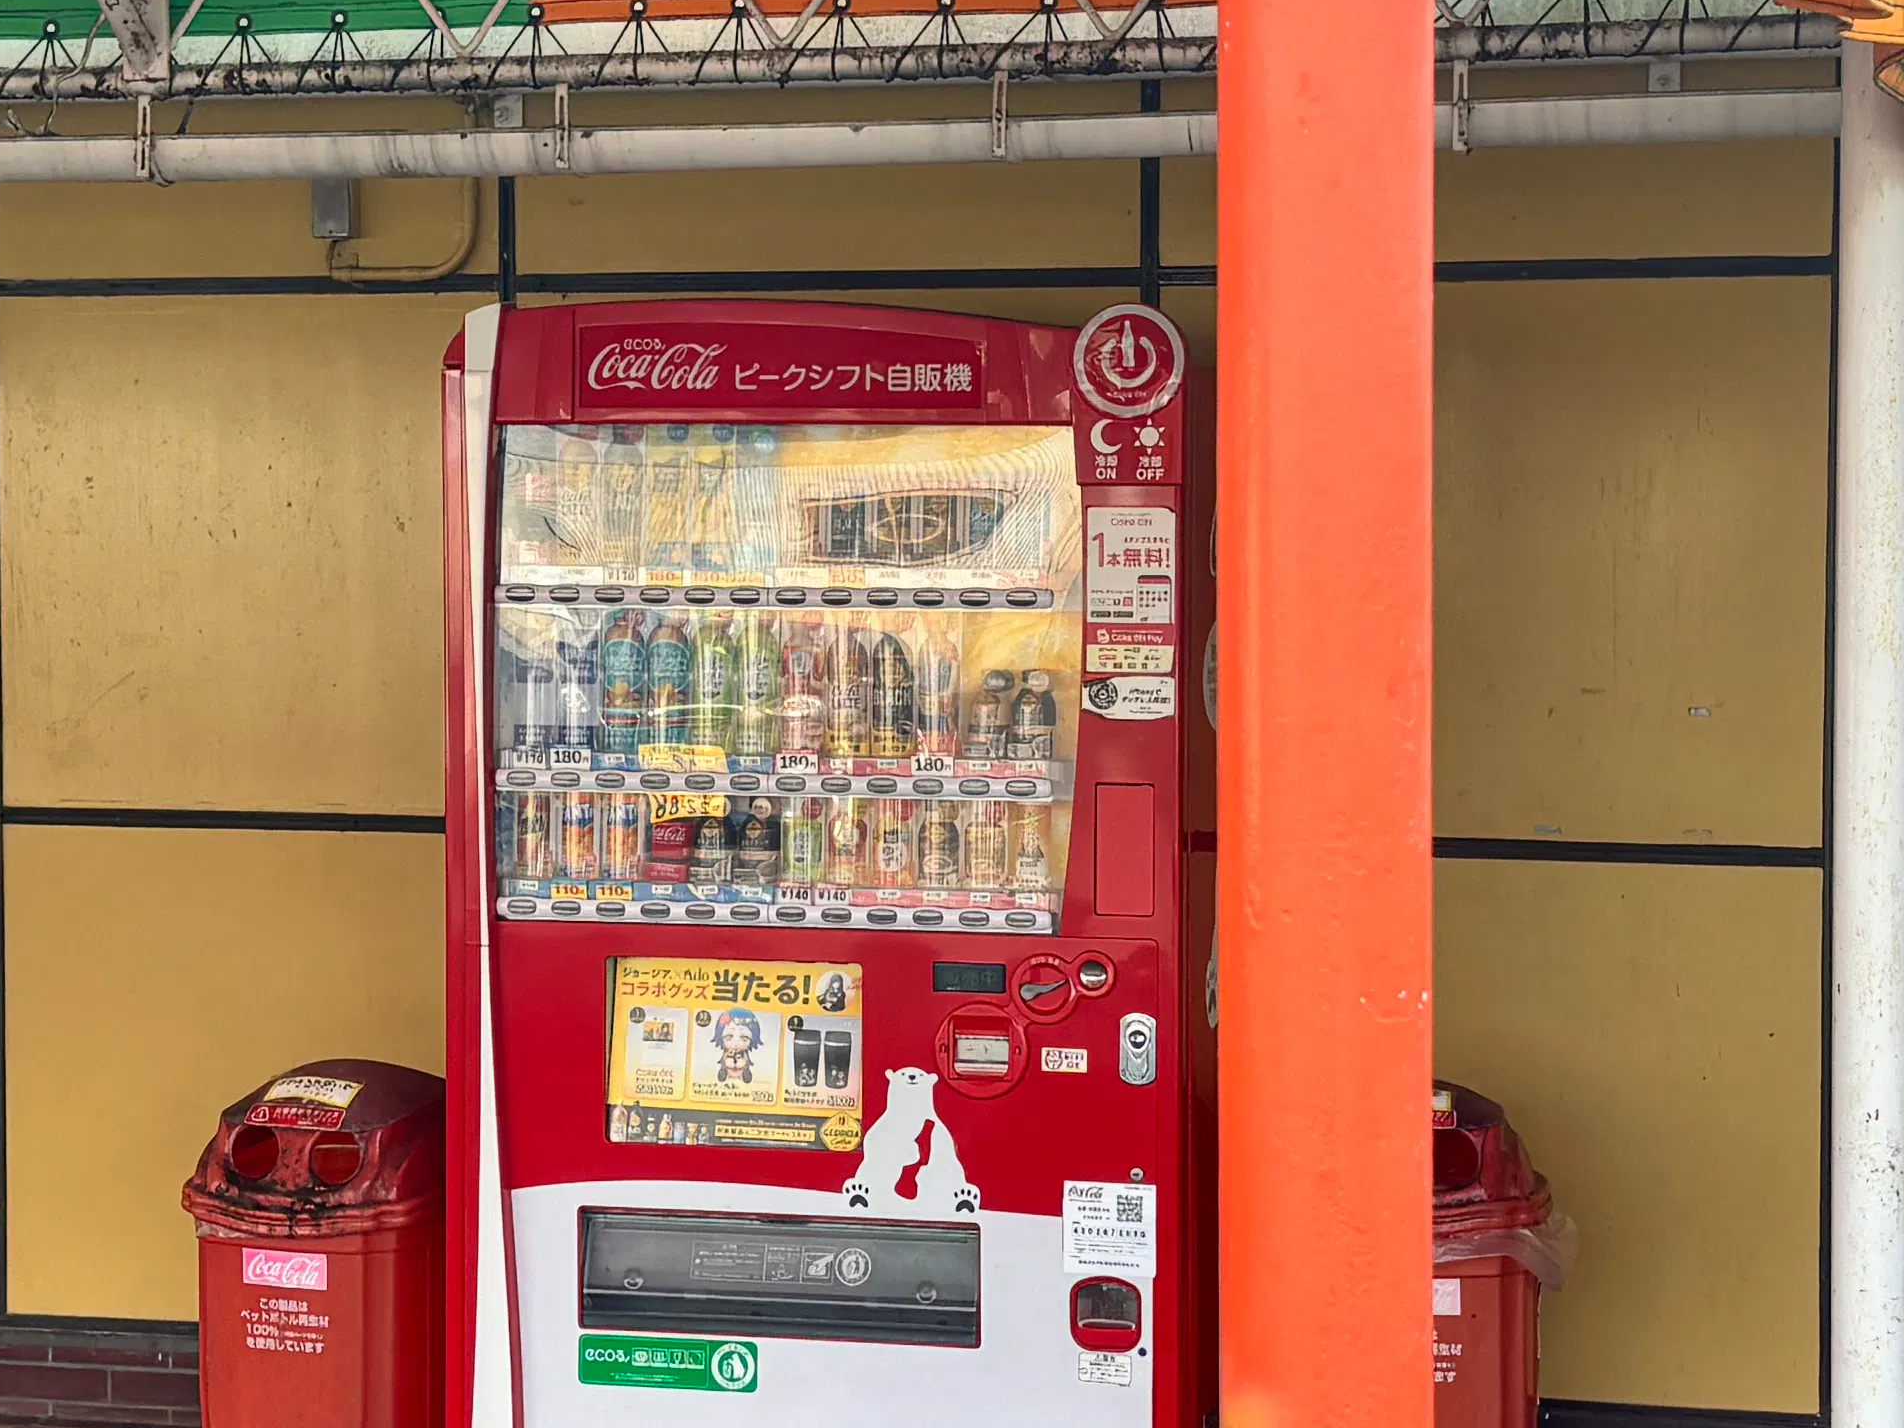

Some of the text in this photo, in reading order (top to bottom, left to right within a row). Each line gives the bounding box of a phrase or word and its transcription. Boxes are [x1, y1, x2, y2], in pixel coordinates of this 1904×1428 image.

[734, 362, 973, 392] ピークシフト自販機
[1096, 468, 1117, 480] ON
[1136, 469, 1164, 481] OFF
[621, 982, 710, 1000] コラボグッズ
[712, 969, 811, 1004] 当たる!
